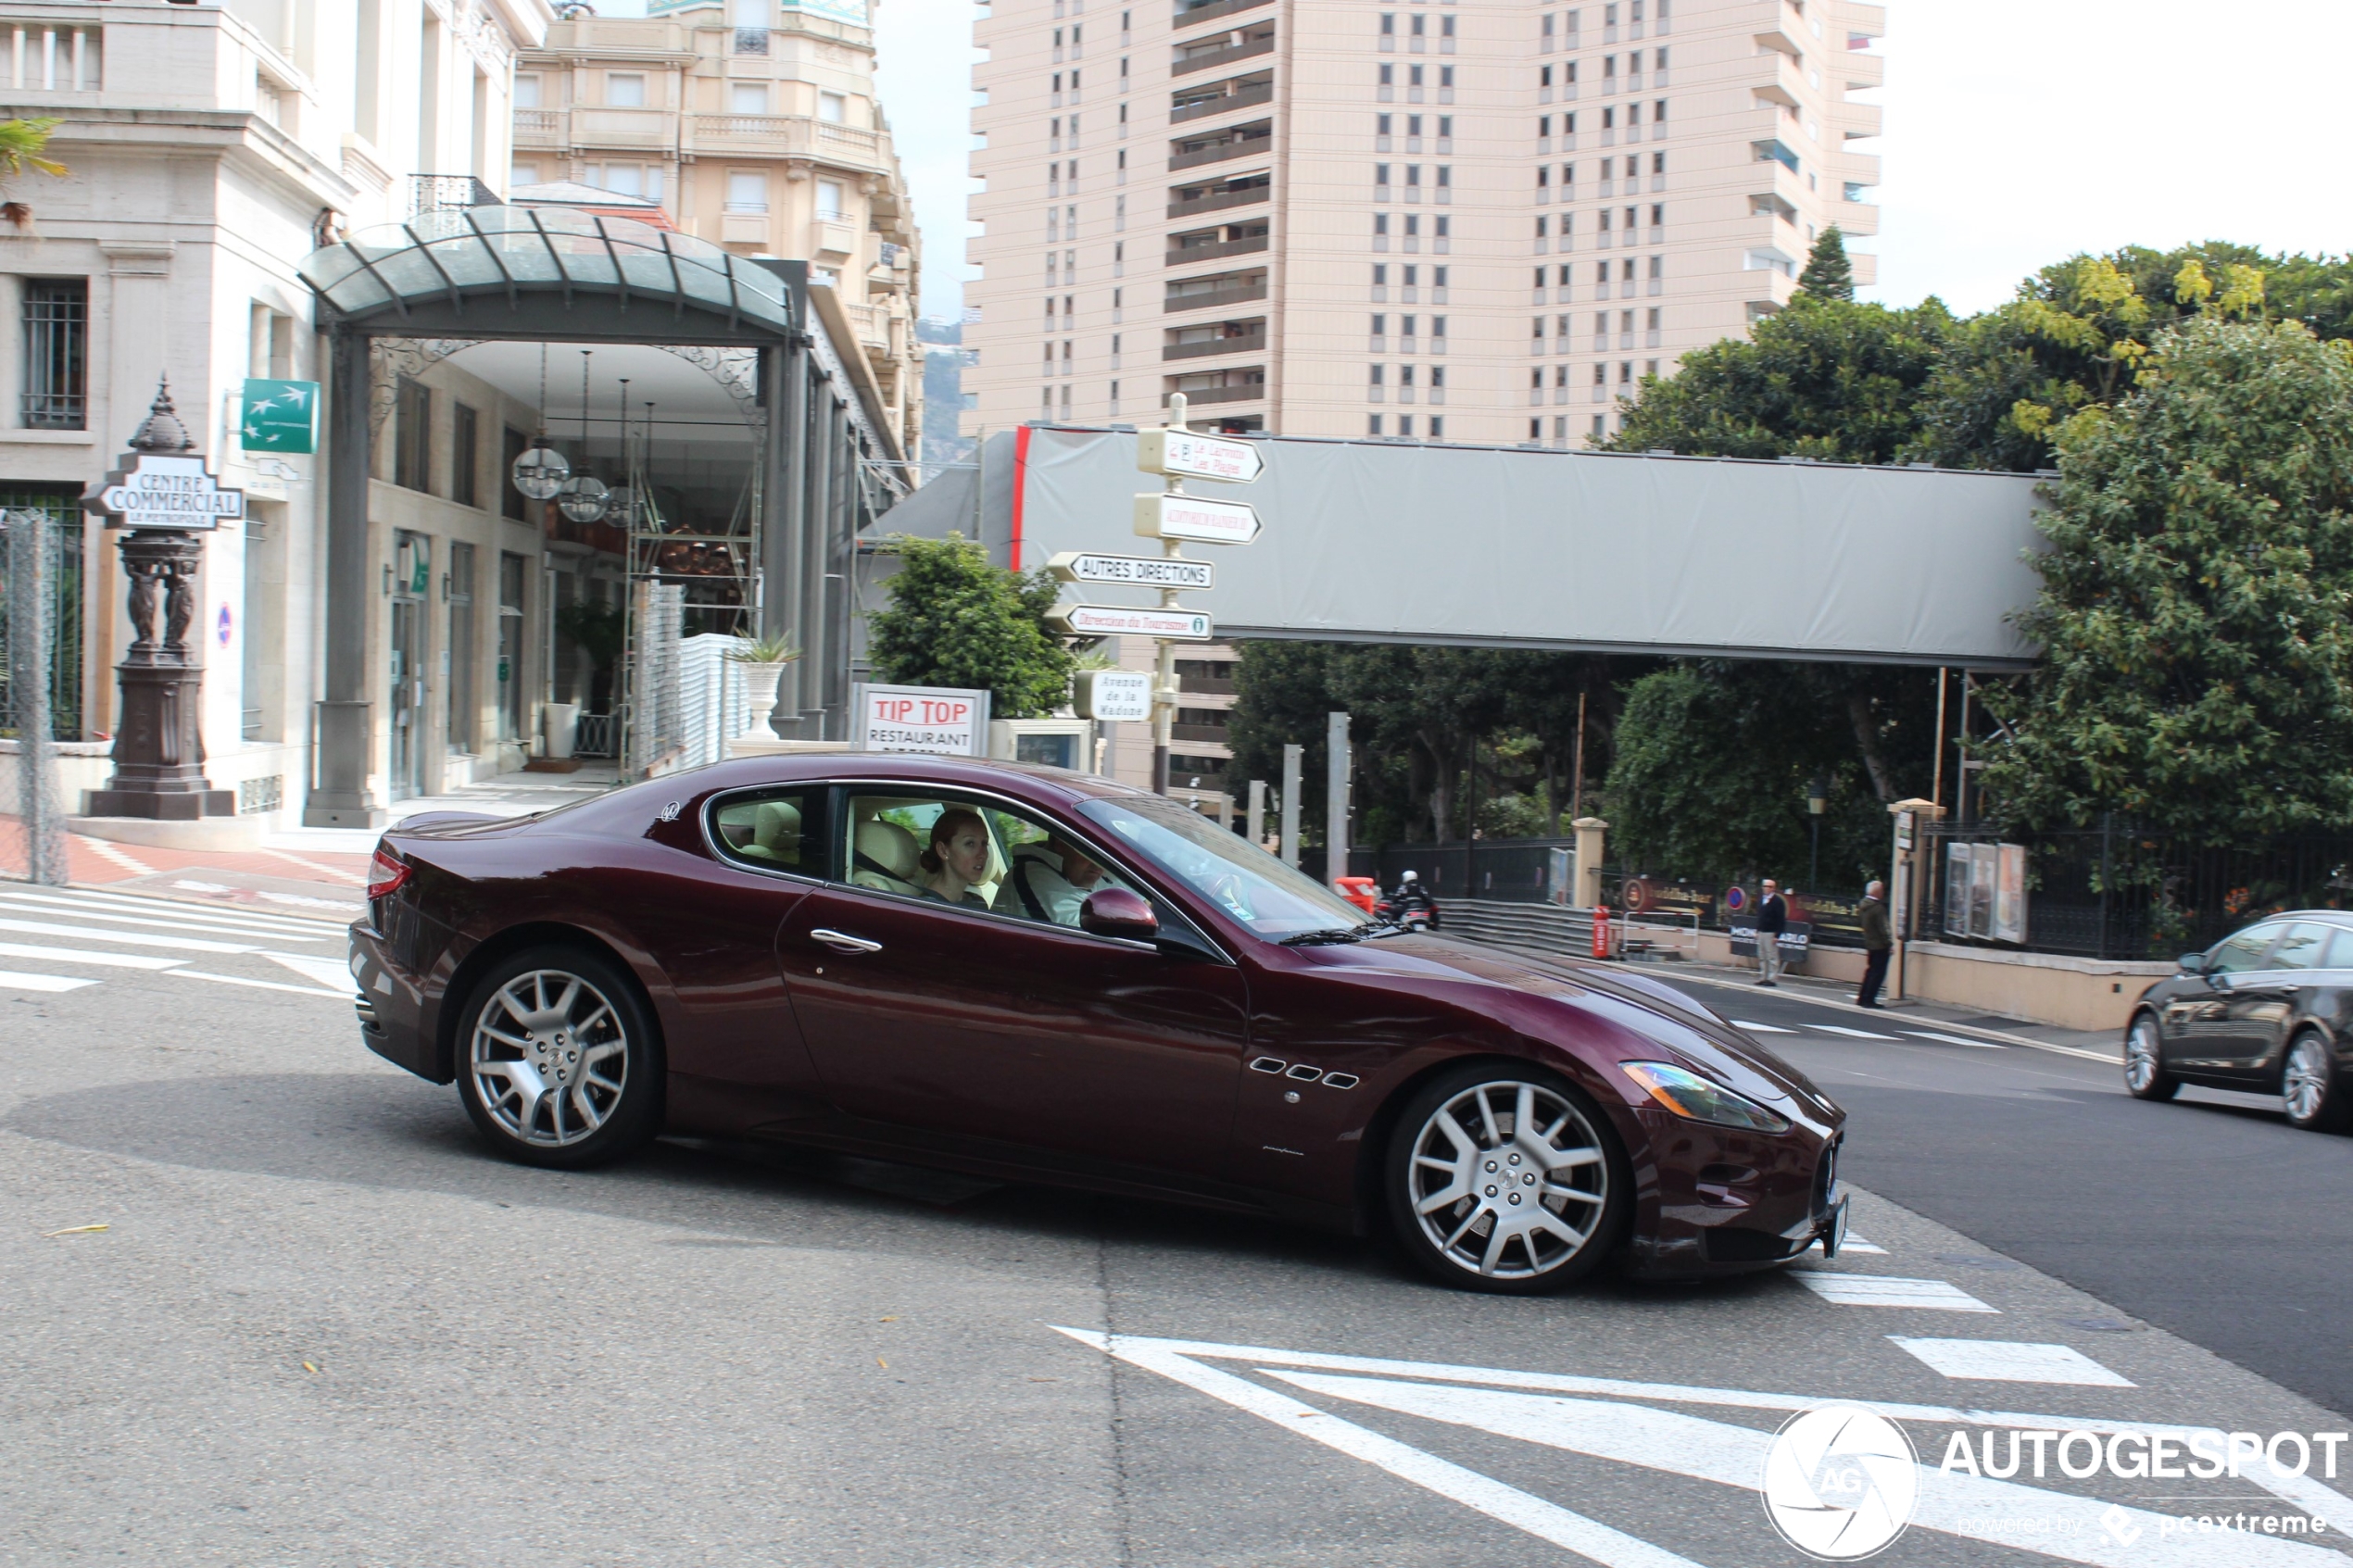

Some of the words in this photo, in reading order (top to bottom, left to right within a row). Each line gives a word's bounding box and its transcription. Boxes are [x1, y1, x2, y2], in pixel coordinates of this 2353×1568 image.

[141, 474, 203, 492] CENTRE
[113, 491, 236, 513] COMMERCIAL
[1082, 559, 1131, 578] AUTRES
[1137, 563, 1206, 583] DIRECTIONS
[1078, 613, 1126, 627] Direction
[1128, 615, 1140, 628] du
[1143, 616, 1189, 631] Tourisme
[875, 700, 914, 721] TIP
[920, 700, 968, 724] TOP
[869, 729, 970, 746] RESTAURANT
[1796, 897, 1860, 917] buddha-b
